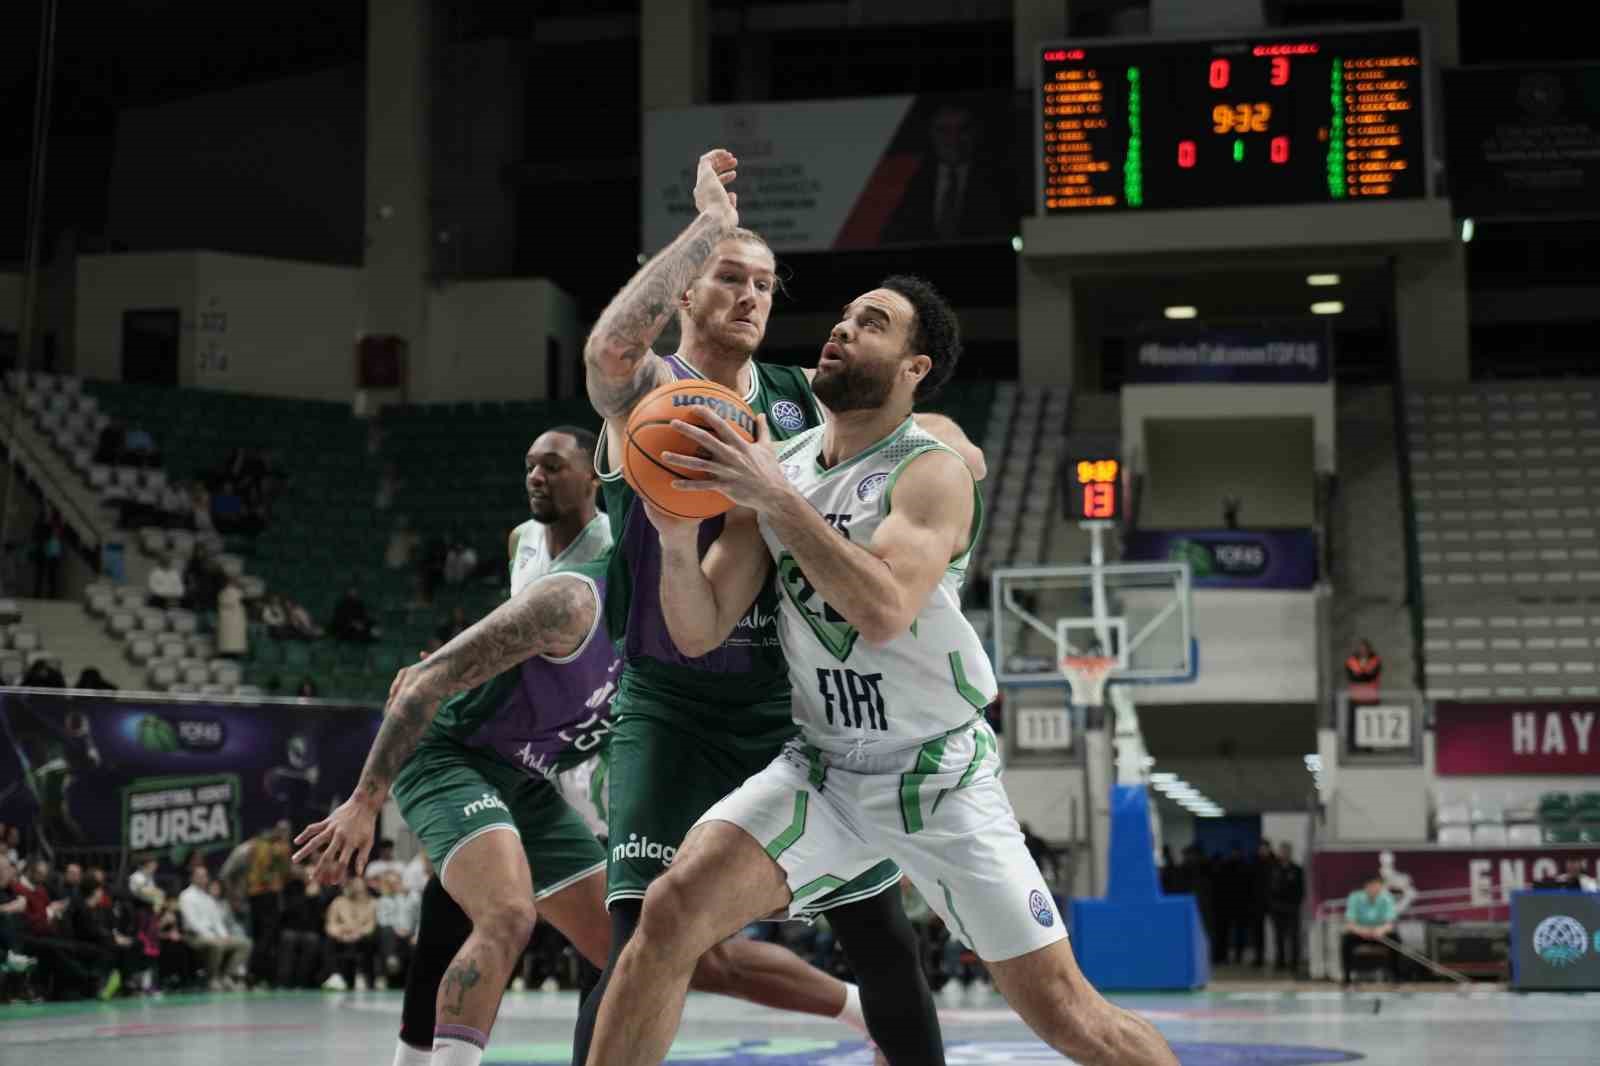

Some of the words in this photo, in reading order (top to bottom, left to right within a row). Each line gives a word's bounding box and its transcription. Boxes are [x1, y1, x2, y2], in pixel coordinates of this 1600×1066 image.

[1209, 59, 1230, 88] 0
[1270, 57, 1289, 85] 3
[1213, 103, 1271, 133] 9:32
[1178, 141, 1197, 168] 0
[1233, 139, 1244, 162] 1
[1271, 137, 1289, 164] 0
[816, 668, 888, 731] FIAT
[1363, 712, 1404, 742] 112
[130, 803, 230, 849] BURSA
